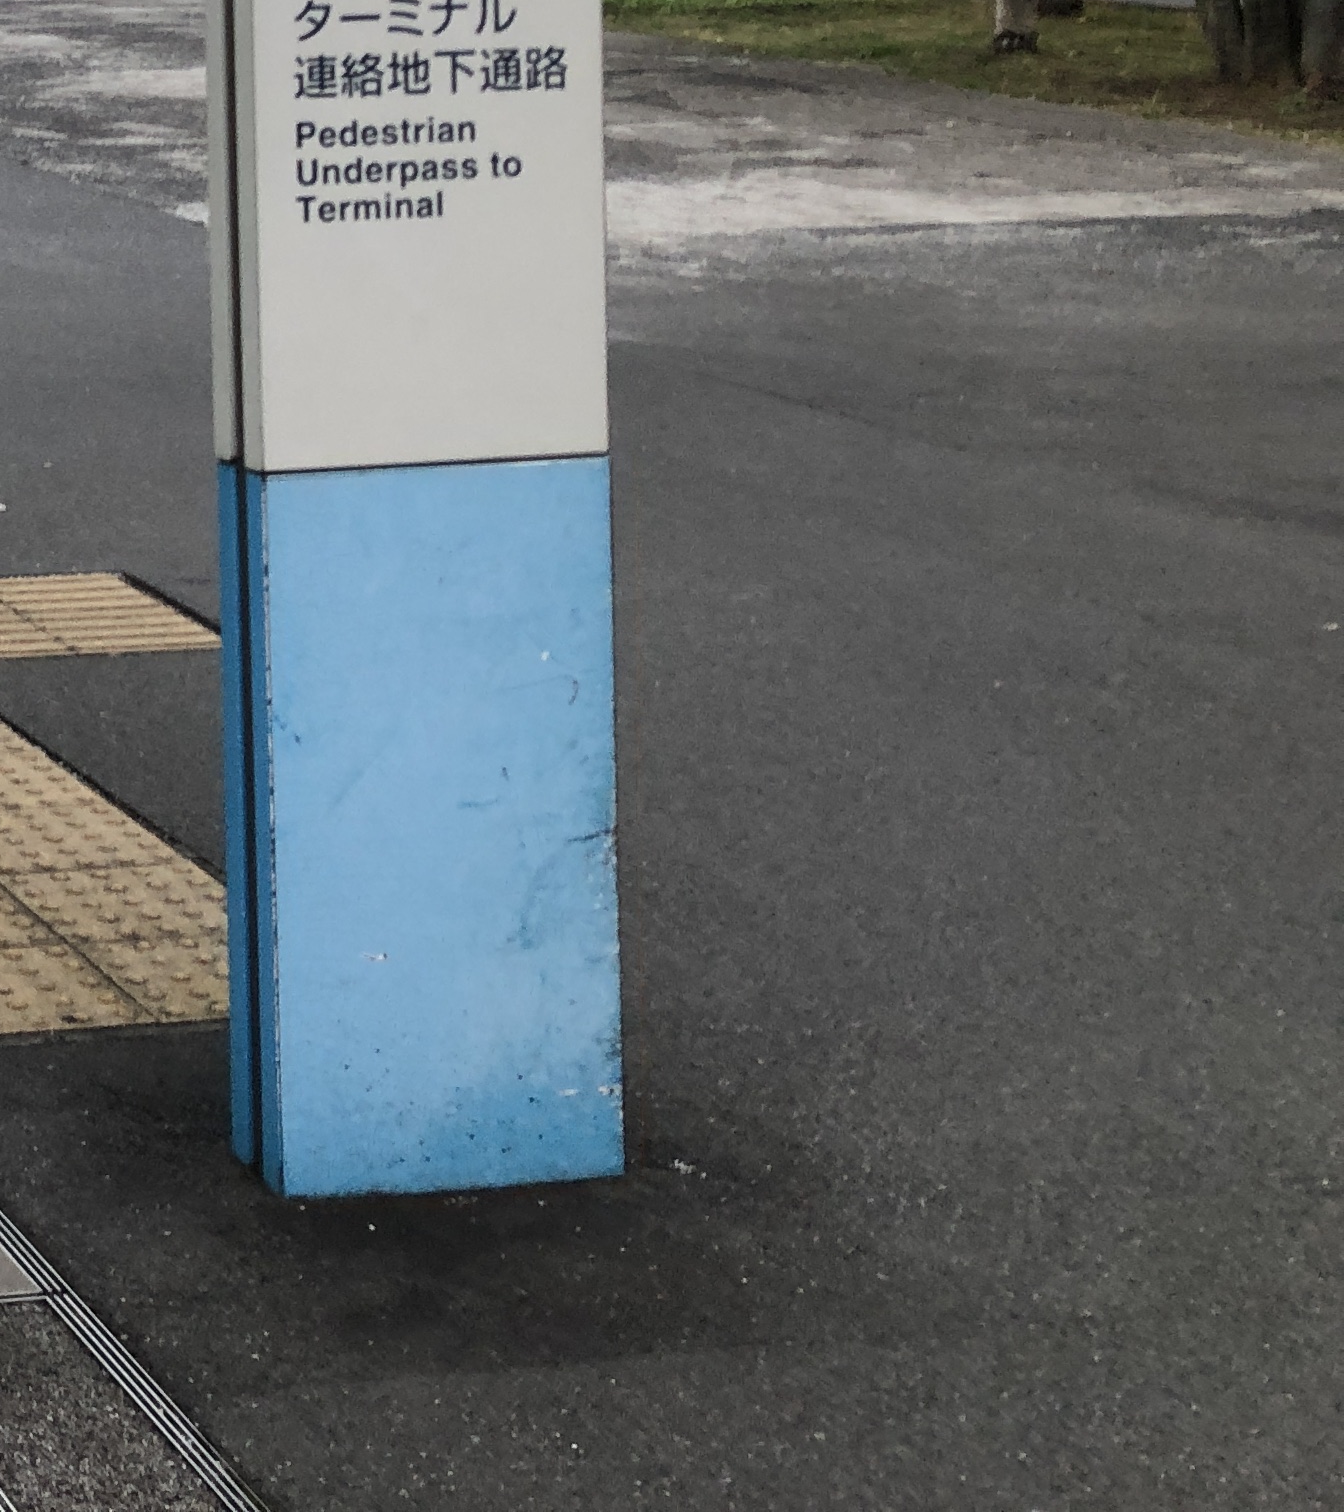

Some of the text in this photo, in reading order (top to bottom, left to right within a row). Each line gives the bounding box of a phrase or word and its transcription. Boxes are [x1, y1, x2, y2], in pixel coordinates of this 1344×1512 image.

[294, 45, 568, 99] 連絡地下通路
[295, 115, 477, 151] Pedestrian
[296, 153, 523, 190] Underpass to
[296, 189, 444, 224] Terminal
